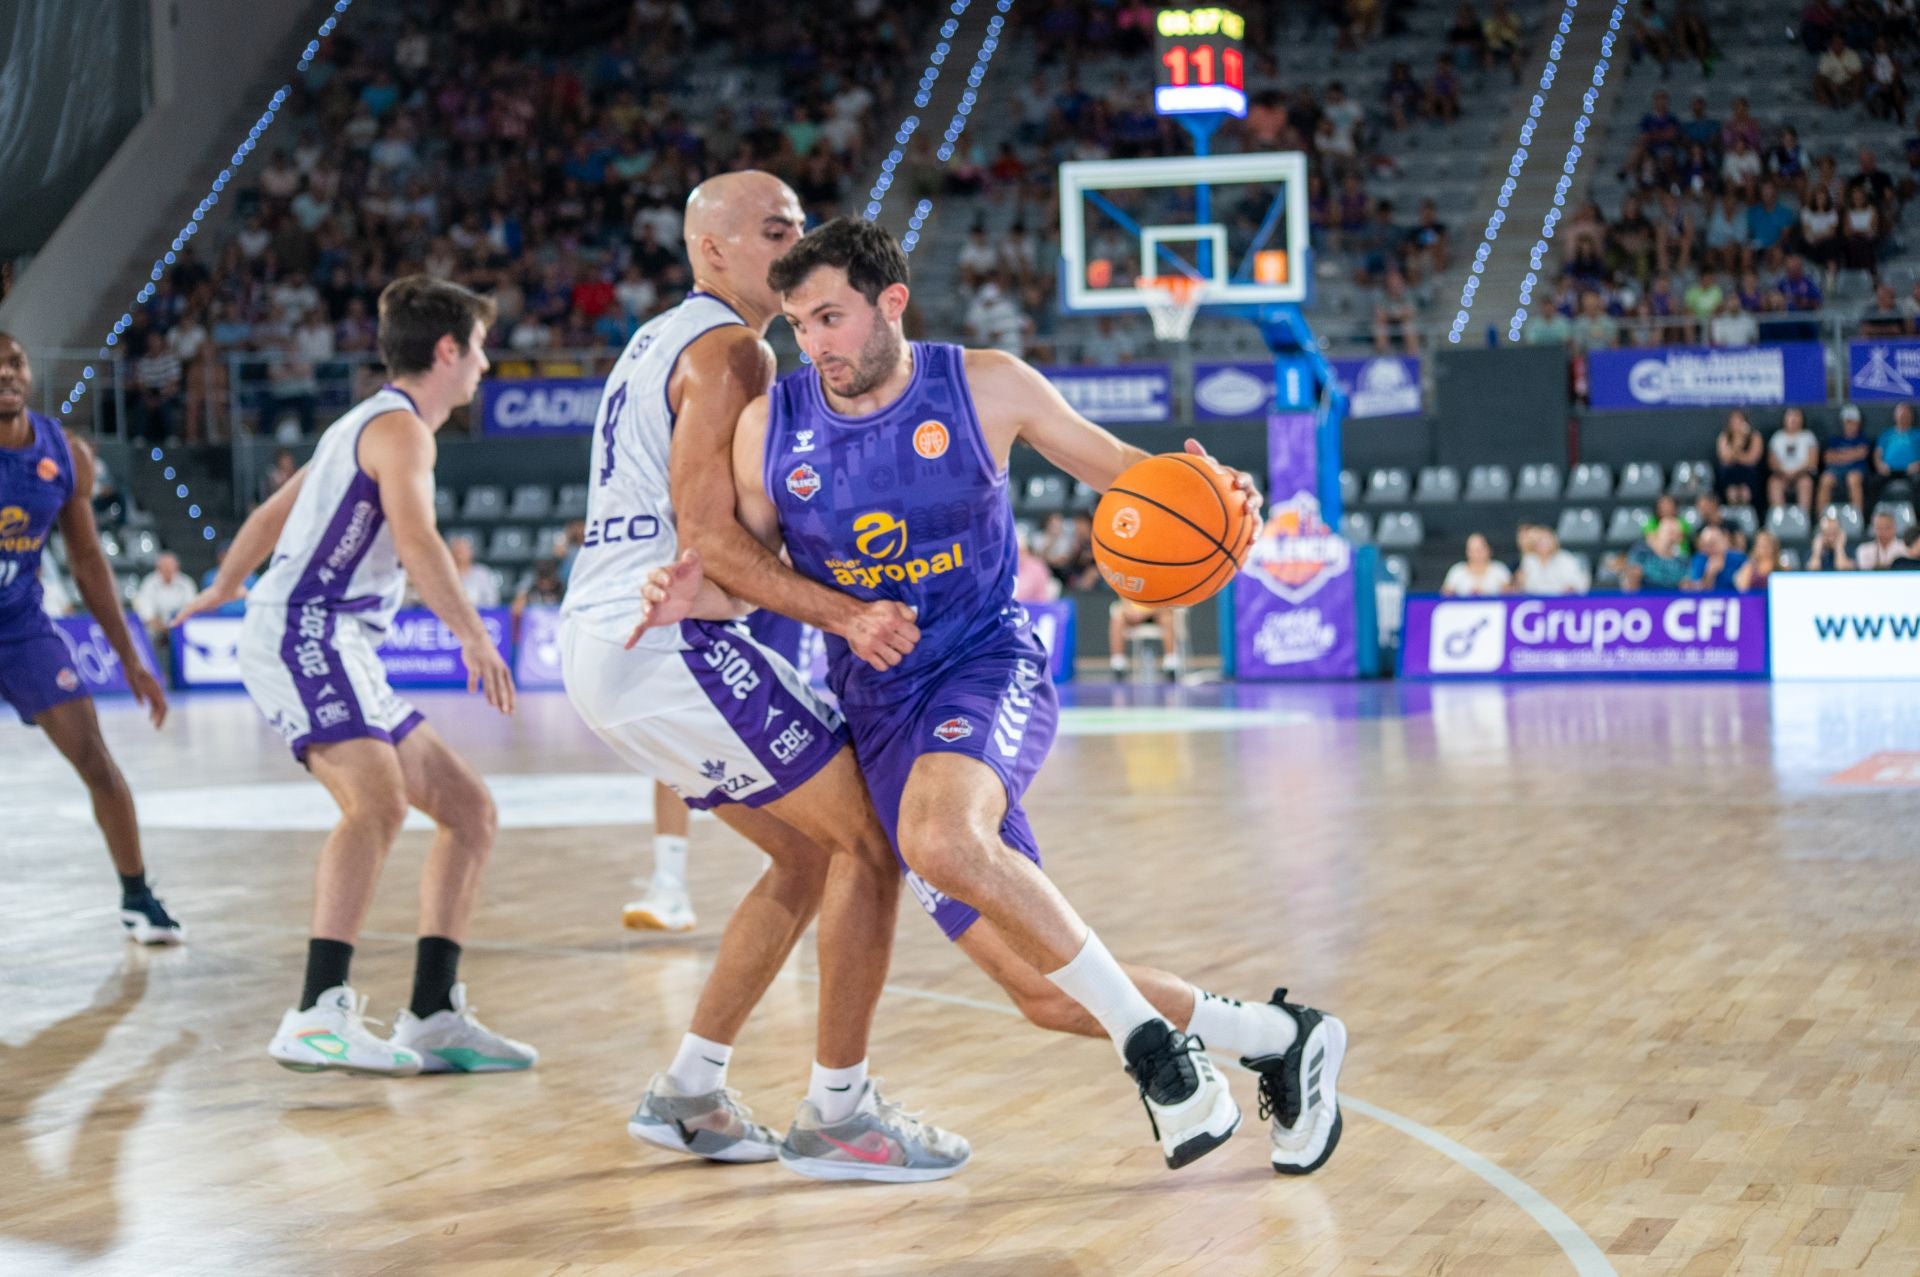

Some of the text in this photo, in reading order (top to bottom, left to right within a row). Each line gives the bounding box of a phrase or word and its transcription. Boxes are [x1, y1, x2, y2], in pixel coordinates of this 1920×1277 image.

[1511, 598, 1741, 653] Grupo CFI
[1814, 615, 1920, 642] www
[769, 720, 809, 760] CBC
